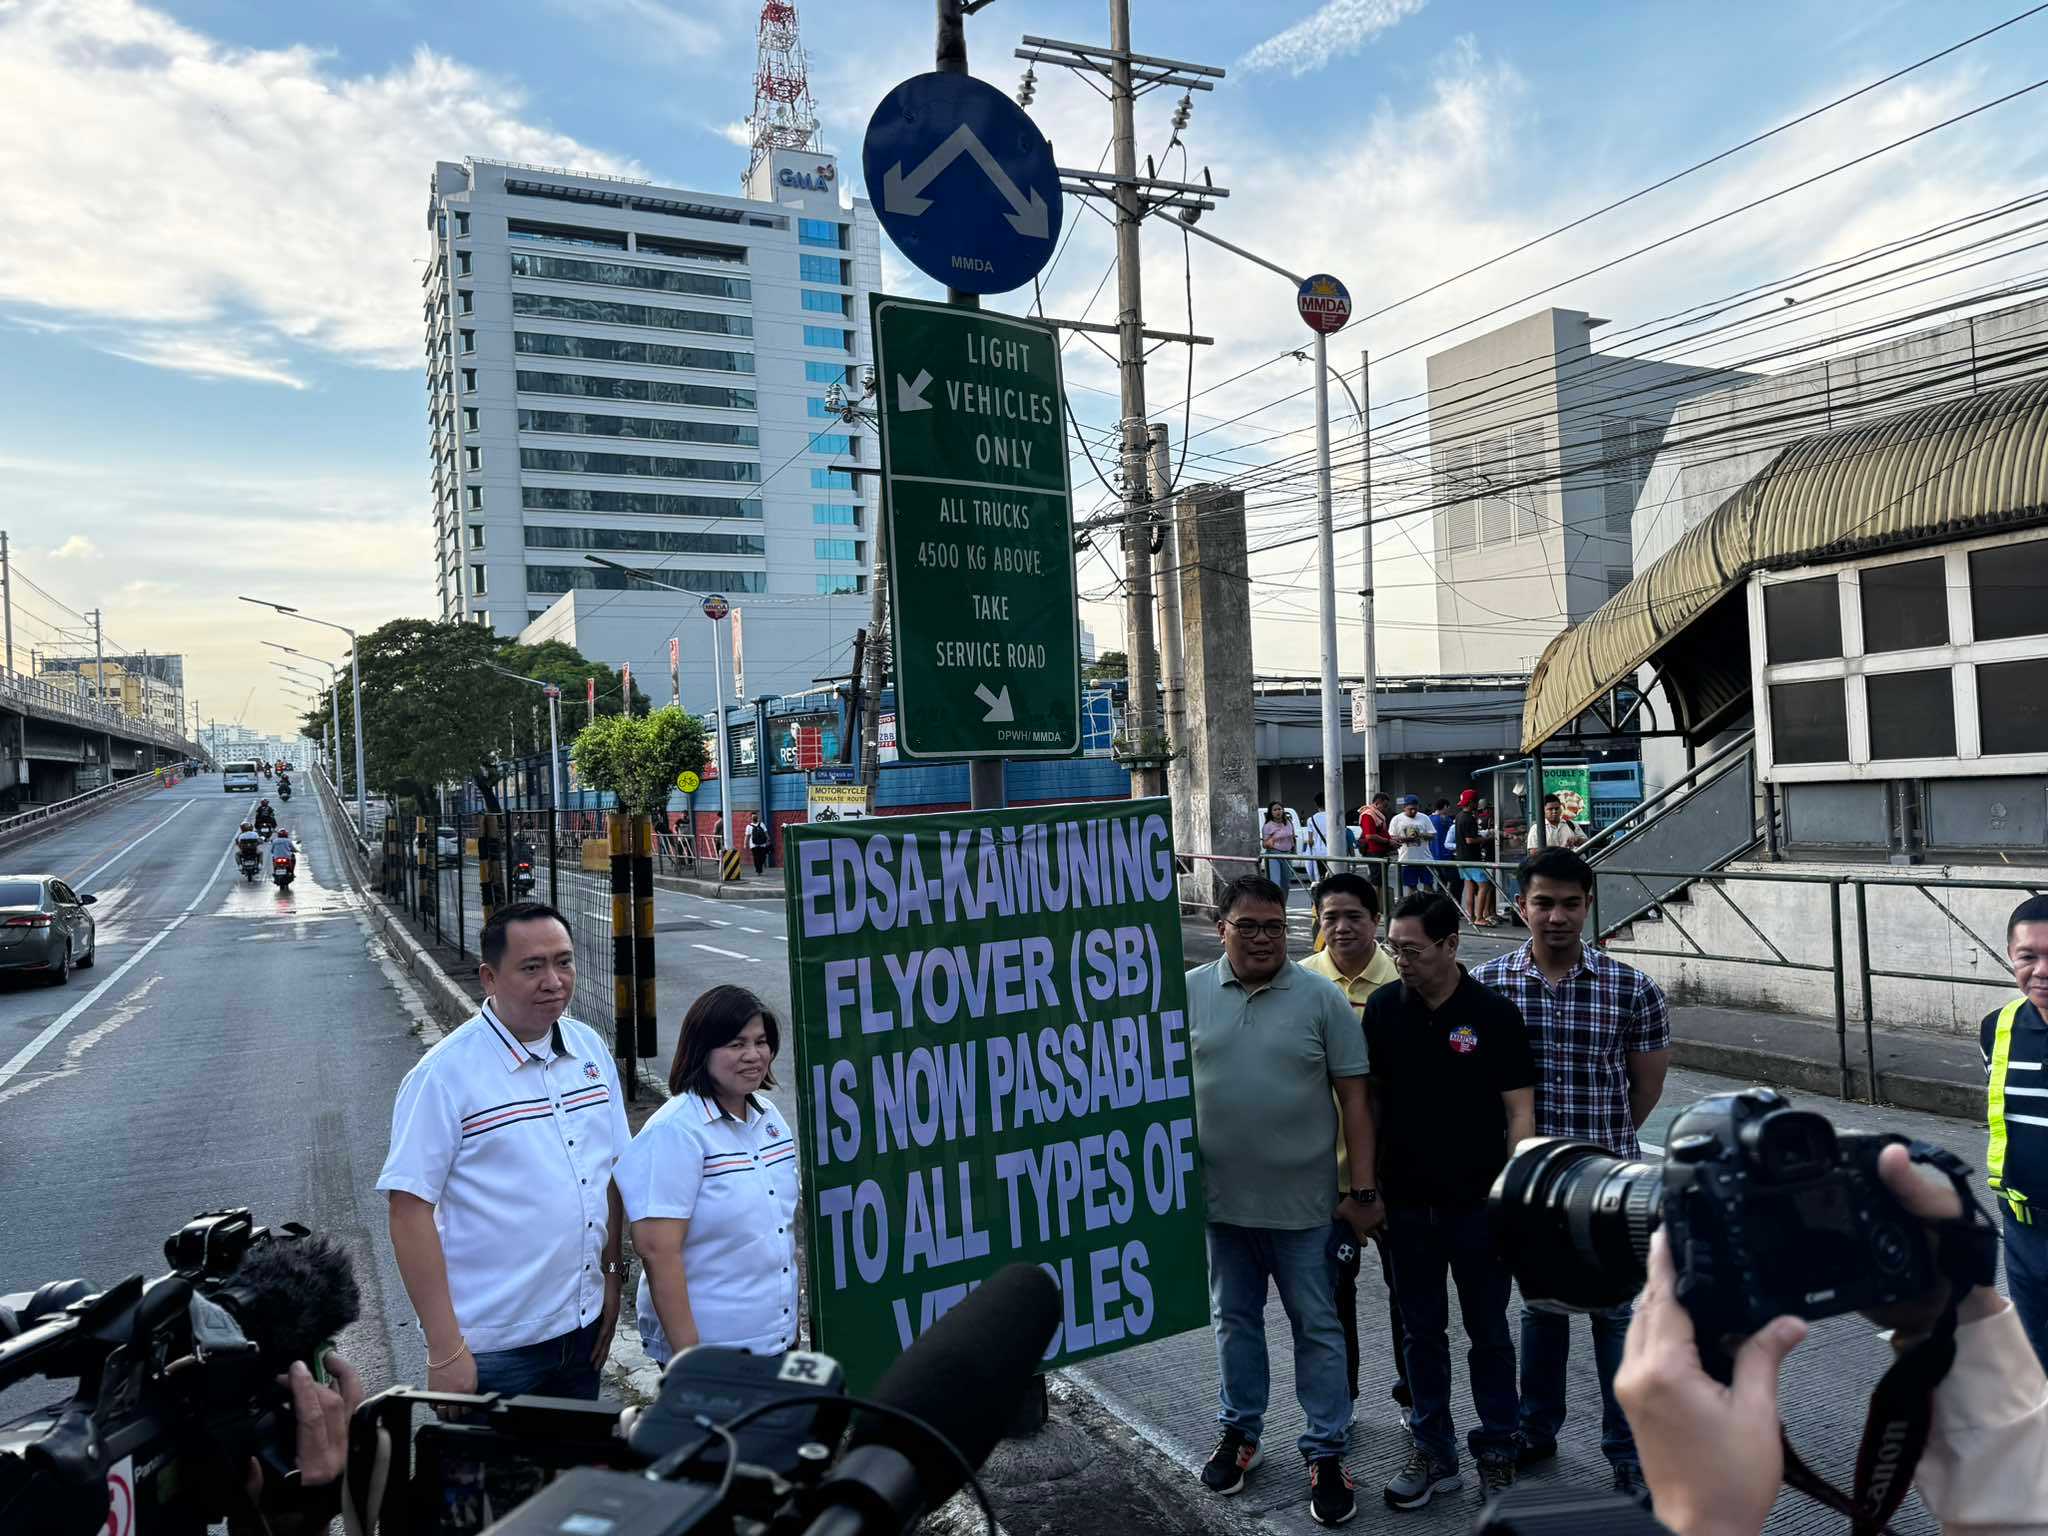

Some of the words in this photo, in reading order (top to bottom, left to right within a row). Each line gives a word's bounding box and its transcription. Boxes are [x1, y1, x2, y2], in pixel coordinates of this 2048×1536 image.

[779, 168, 829, 192] GMA
[951, 255, 994, 273] MMDA
[1301, 296, 1347, 314] MMDA
[967, 332, 1030, 373] LIGHT
[946, 379, 1053, 425] VEHICLES
[976, 433, 1033, 470] ONLY
[940, 497, 968, 524] ALL
[973, 499, 1030, 530] TRUCKS
[918, 541, 960, 569] 4500
[967, 544, 987, 571] KG
[994, 548, 1042, 575] ABOVE
[972, 594, 1010, 621] TAKE
[936, 641, 1001, 668] SERVICE
[1007, 643, 1046, 669] ROAD
[815, 787, 866, 795] MOTORCYCLE
[799, 814, 1173, 938] EDSA-KAMUNING
[824, 936, 1060, 1040] FLYOVER
[1070, 923, 1162, 1022] (SB)
[812, 1059, 862, 1165] IS
[872, 1040, 977, 1154] NOW
[986, 1010, 1190, 1133] PASSABLE
[819, 1180, 889, 1290] TO
[903, 1161, 990, 1275] ALL
[996, 1129, 1135, 1249] TYPES
[1143, 1118, 1194, 1216] OF
